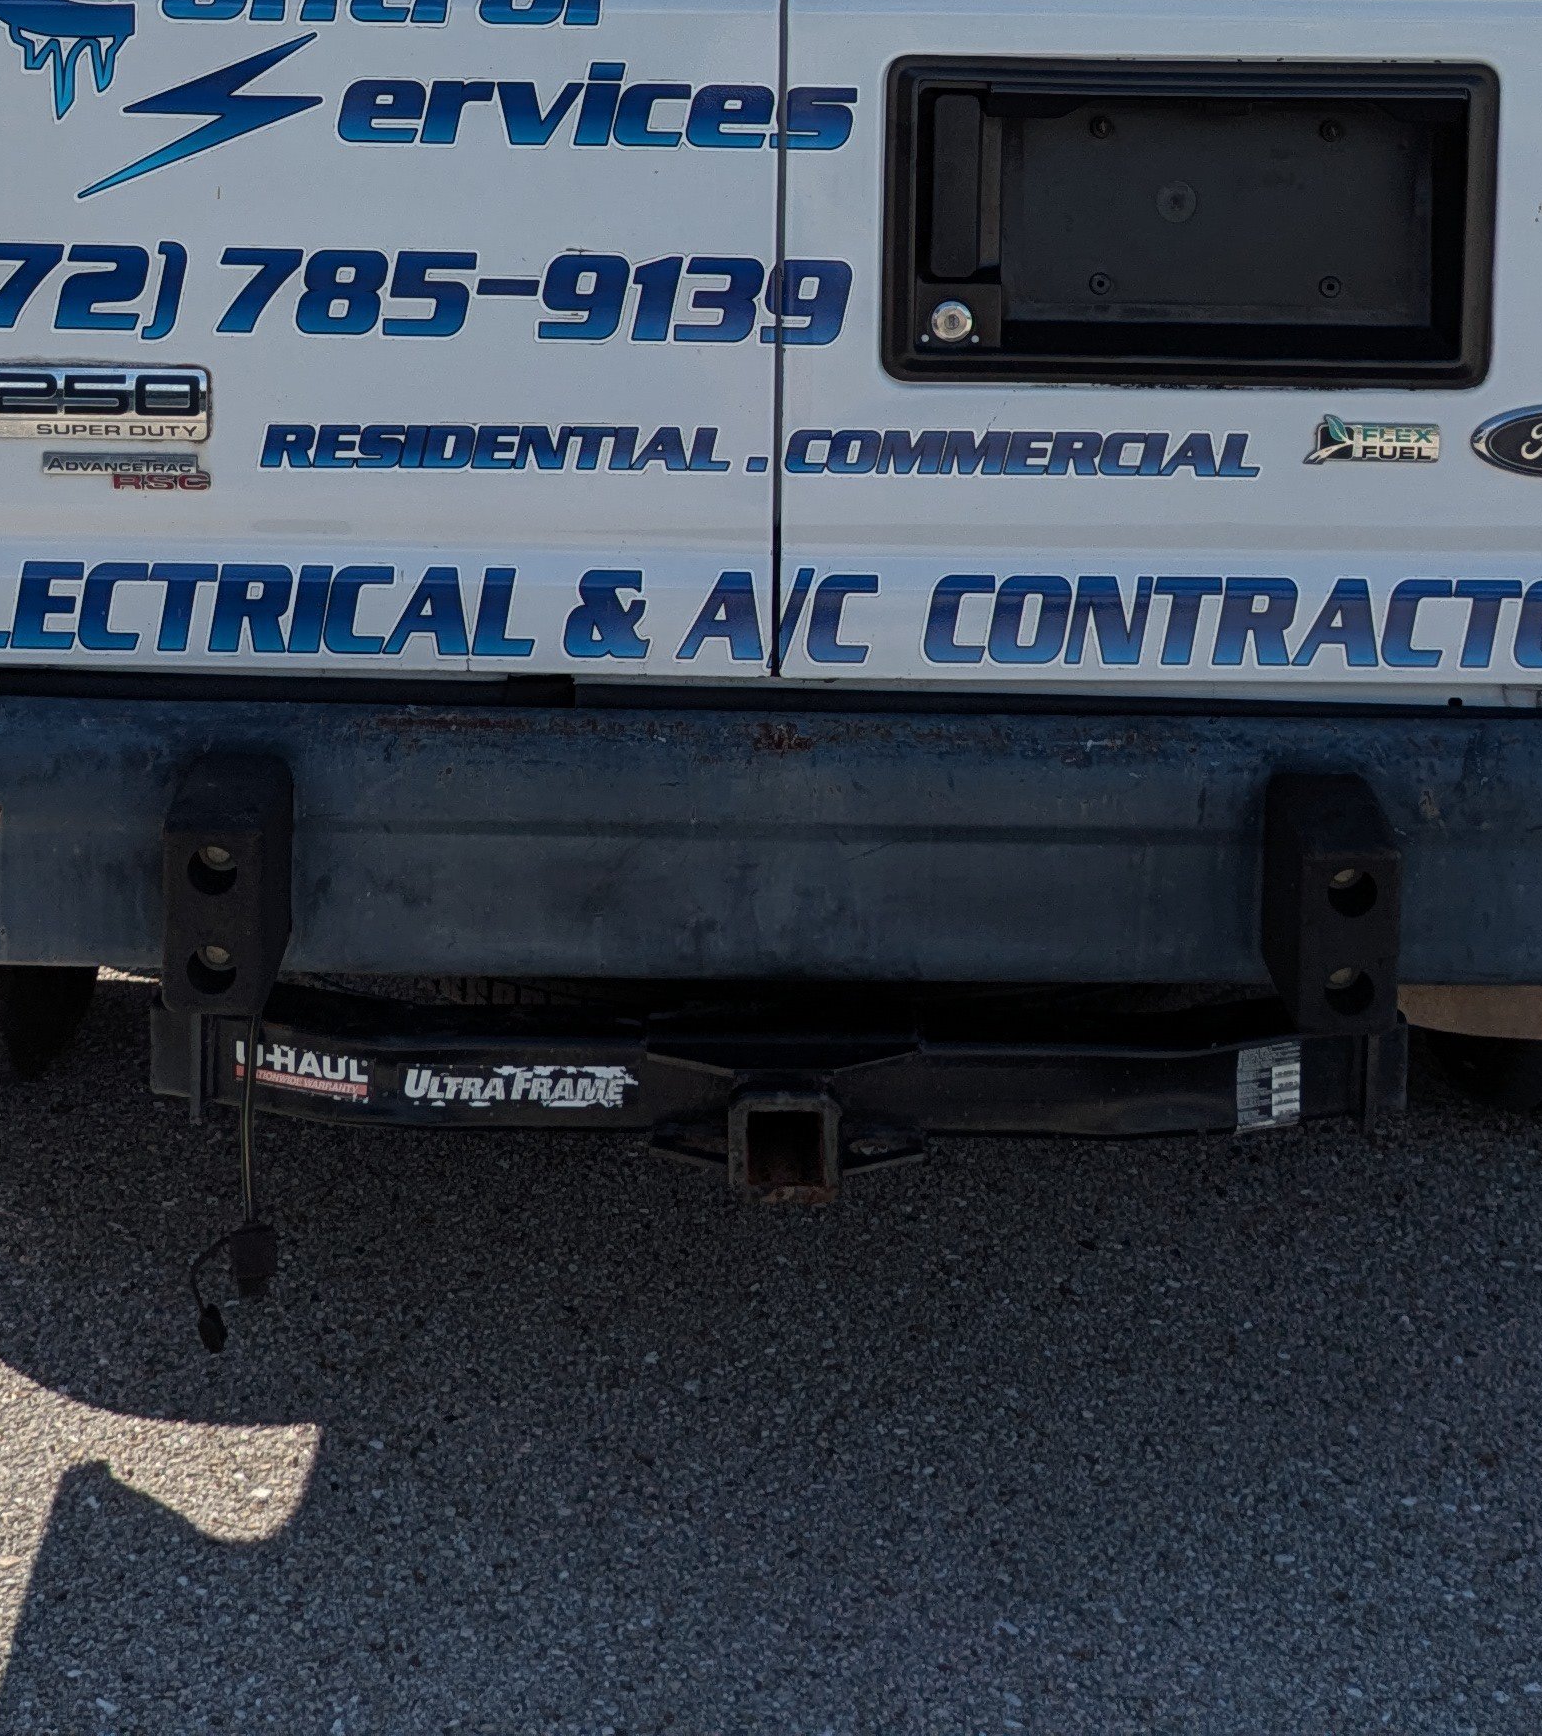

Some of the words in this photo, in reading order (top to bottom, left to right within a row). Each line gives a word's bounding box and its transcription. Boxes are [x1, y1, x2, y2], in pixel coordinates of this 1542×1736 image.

[216, 249, 852, 345] 785-9139
[36, 423, 120, 437] SUPER
[128, 424, 198, 438] DUTY
[1363, 426, 1432, 444] FLEX
[260, 424, 731, 473] RESIDENTIAL
[784, 429, 1260, 478] COMMERCIAL
[1362, 445, 1433, 461] FUEL
[112, 474, 211, 491] RSC
[563, 569, 652, 659] &
[676, 567, 880, 669] A/C
[404, 1067, 506, 1101] ULTRA
[511, 1069, 625, 1102] FRAME
